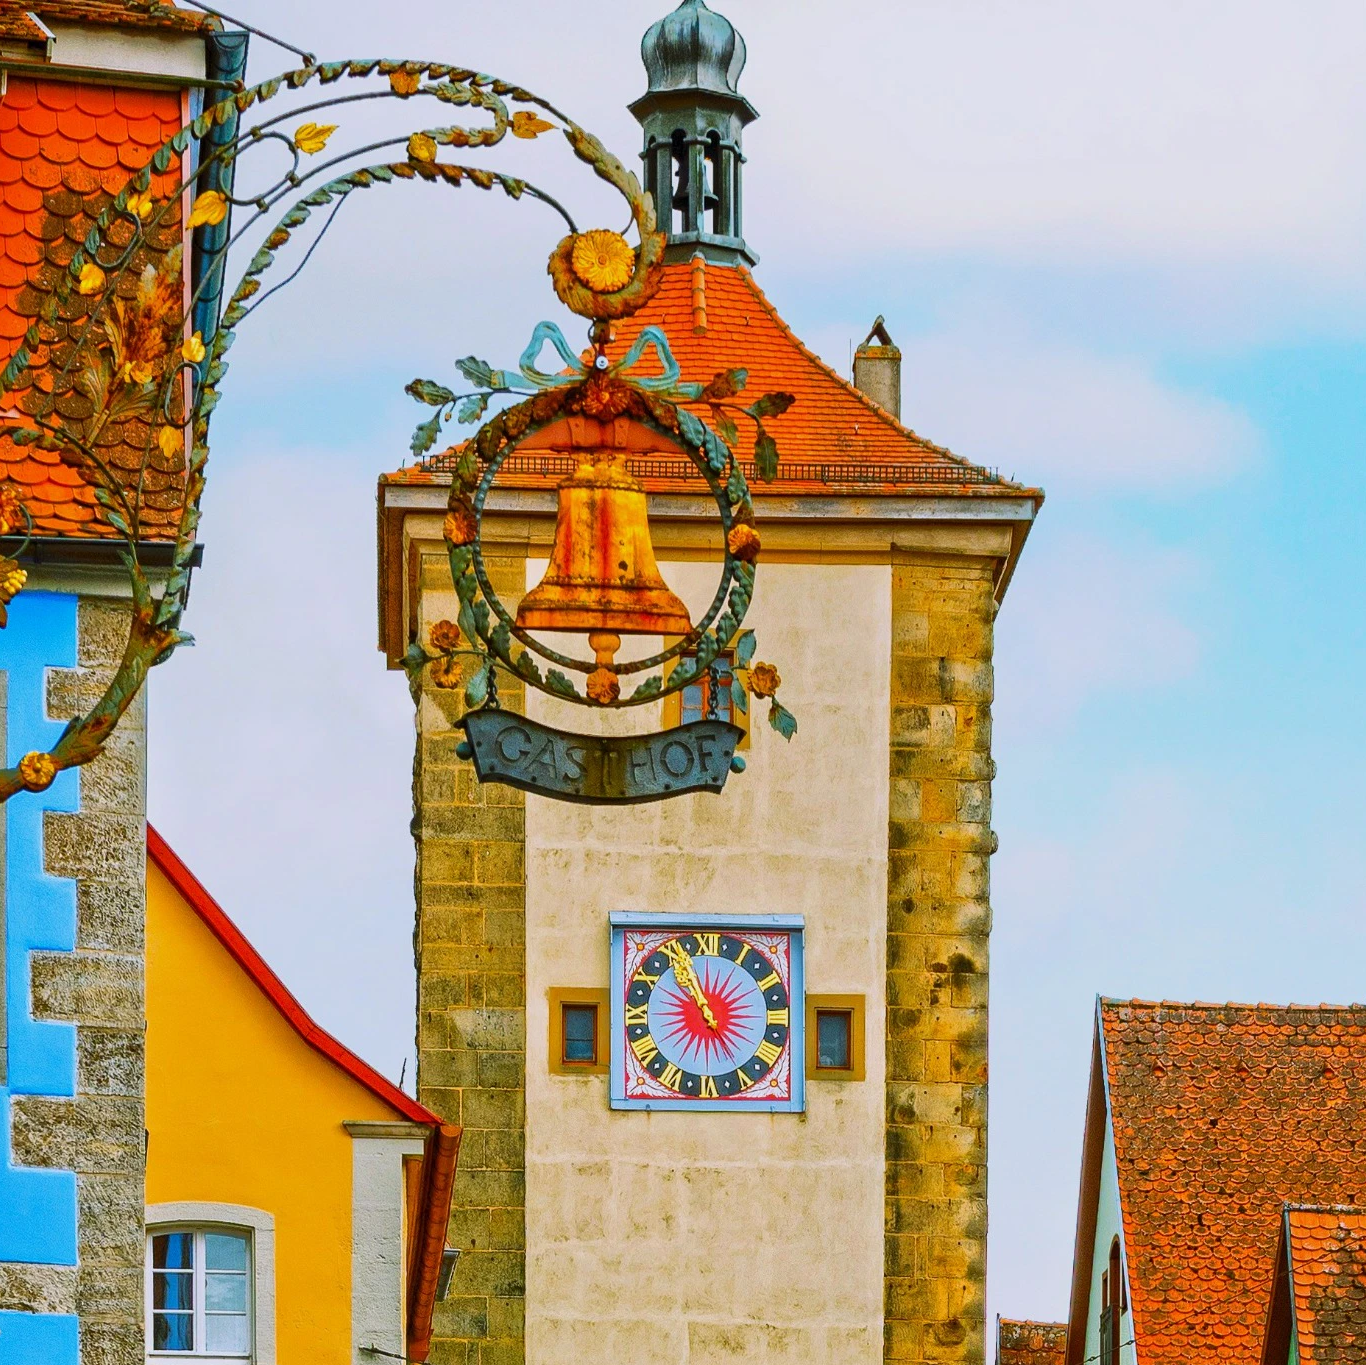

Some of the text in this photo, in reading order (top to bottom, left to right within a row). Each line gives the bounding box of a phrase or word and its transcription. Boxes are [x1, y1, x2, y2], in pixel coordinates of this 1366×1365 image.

[494, 725, 717, 788] GASTHOF
[693, 933, 721, 956] XII
[735, 943, 752, 965] I
[633, 967, 660, 990] X
[757, 970, 782, 992] II
[625, 1003, 648, 1027] IX
[766, 1007, 789, 1028] III
[657, 1062, 684, 1092] VII
[698, 1075, 720, 1098] VI
[736, 1068, 755, 1091] V
